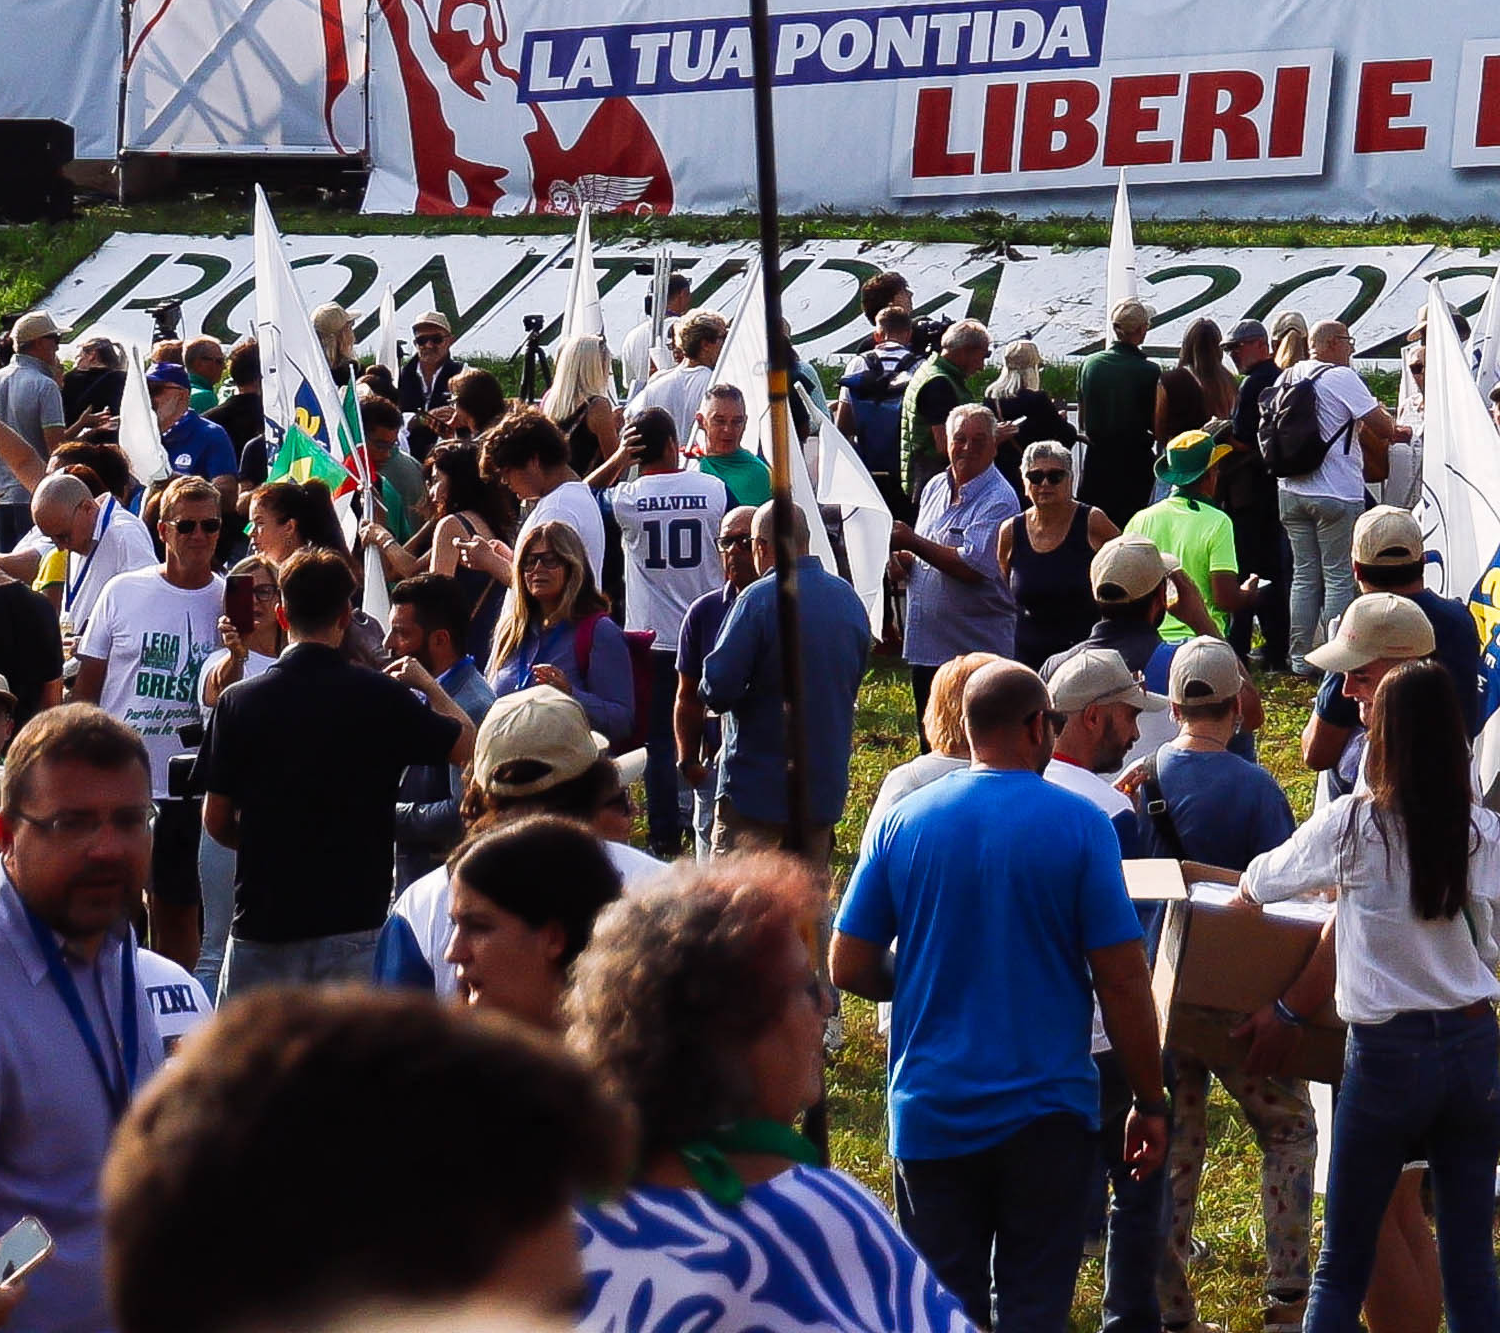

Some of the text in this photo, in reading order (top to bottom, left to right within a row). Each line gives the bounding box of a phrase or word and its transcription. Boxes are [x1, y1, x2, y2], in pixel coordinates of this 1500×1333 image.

[528, 5, 1093, 93] LA TUA PONTIDA
[911, 66, 1311, 179] LIBERI
[1354, 58, 1432, 155] E
[637, 495, 708, 512] SALVINI
[642, 518, 703, 569] 10
